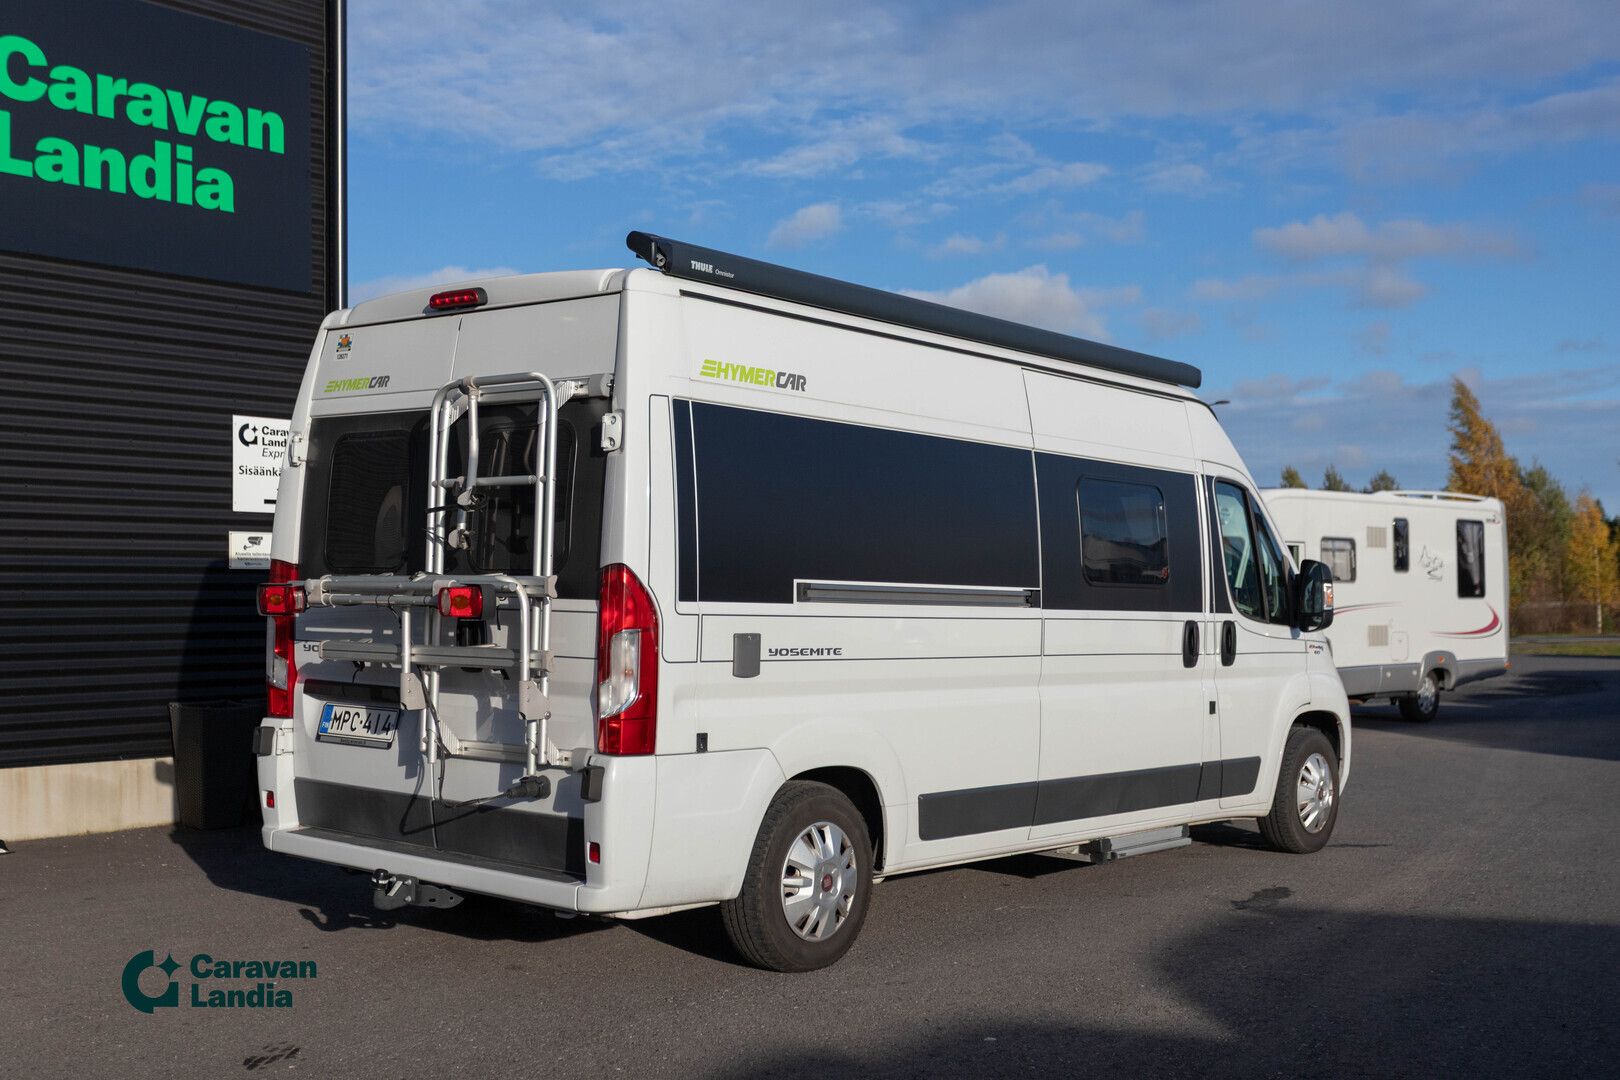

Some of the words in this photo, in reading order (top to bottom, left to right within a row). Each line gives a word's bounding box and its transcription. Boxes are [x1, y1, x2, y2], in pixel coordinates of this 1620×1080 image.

[0, 34, 285, 154] Caravan
[0, 110, 235, 213] Landia
[691, 260, 713, 273] THULE
[768, 647, 842, 657] YOSEMITE
